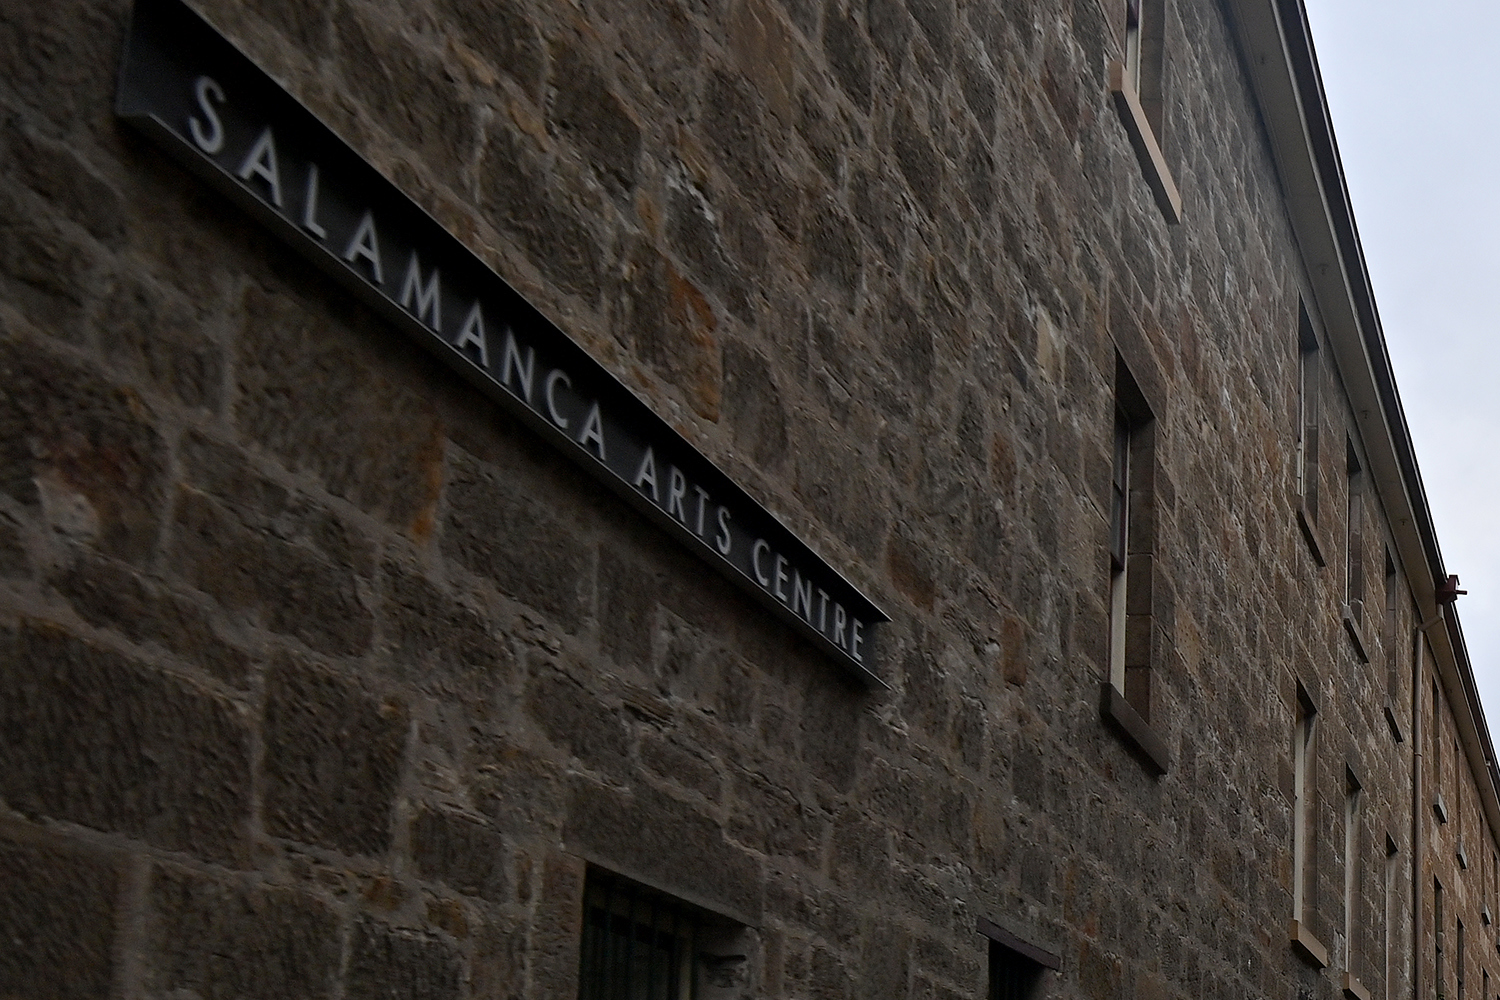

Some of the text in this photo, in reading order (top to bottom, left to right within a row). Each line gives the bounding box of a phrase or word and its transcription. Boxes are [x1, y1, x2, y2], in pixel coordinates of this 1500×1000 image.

[188, 74, 865, 662] SALAMANCA ARTS CENTRE
